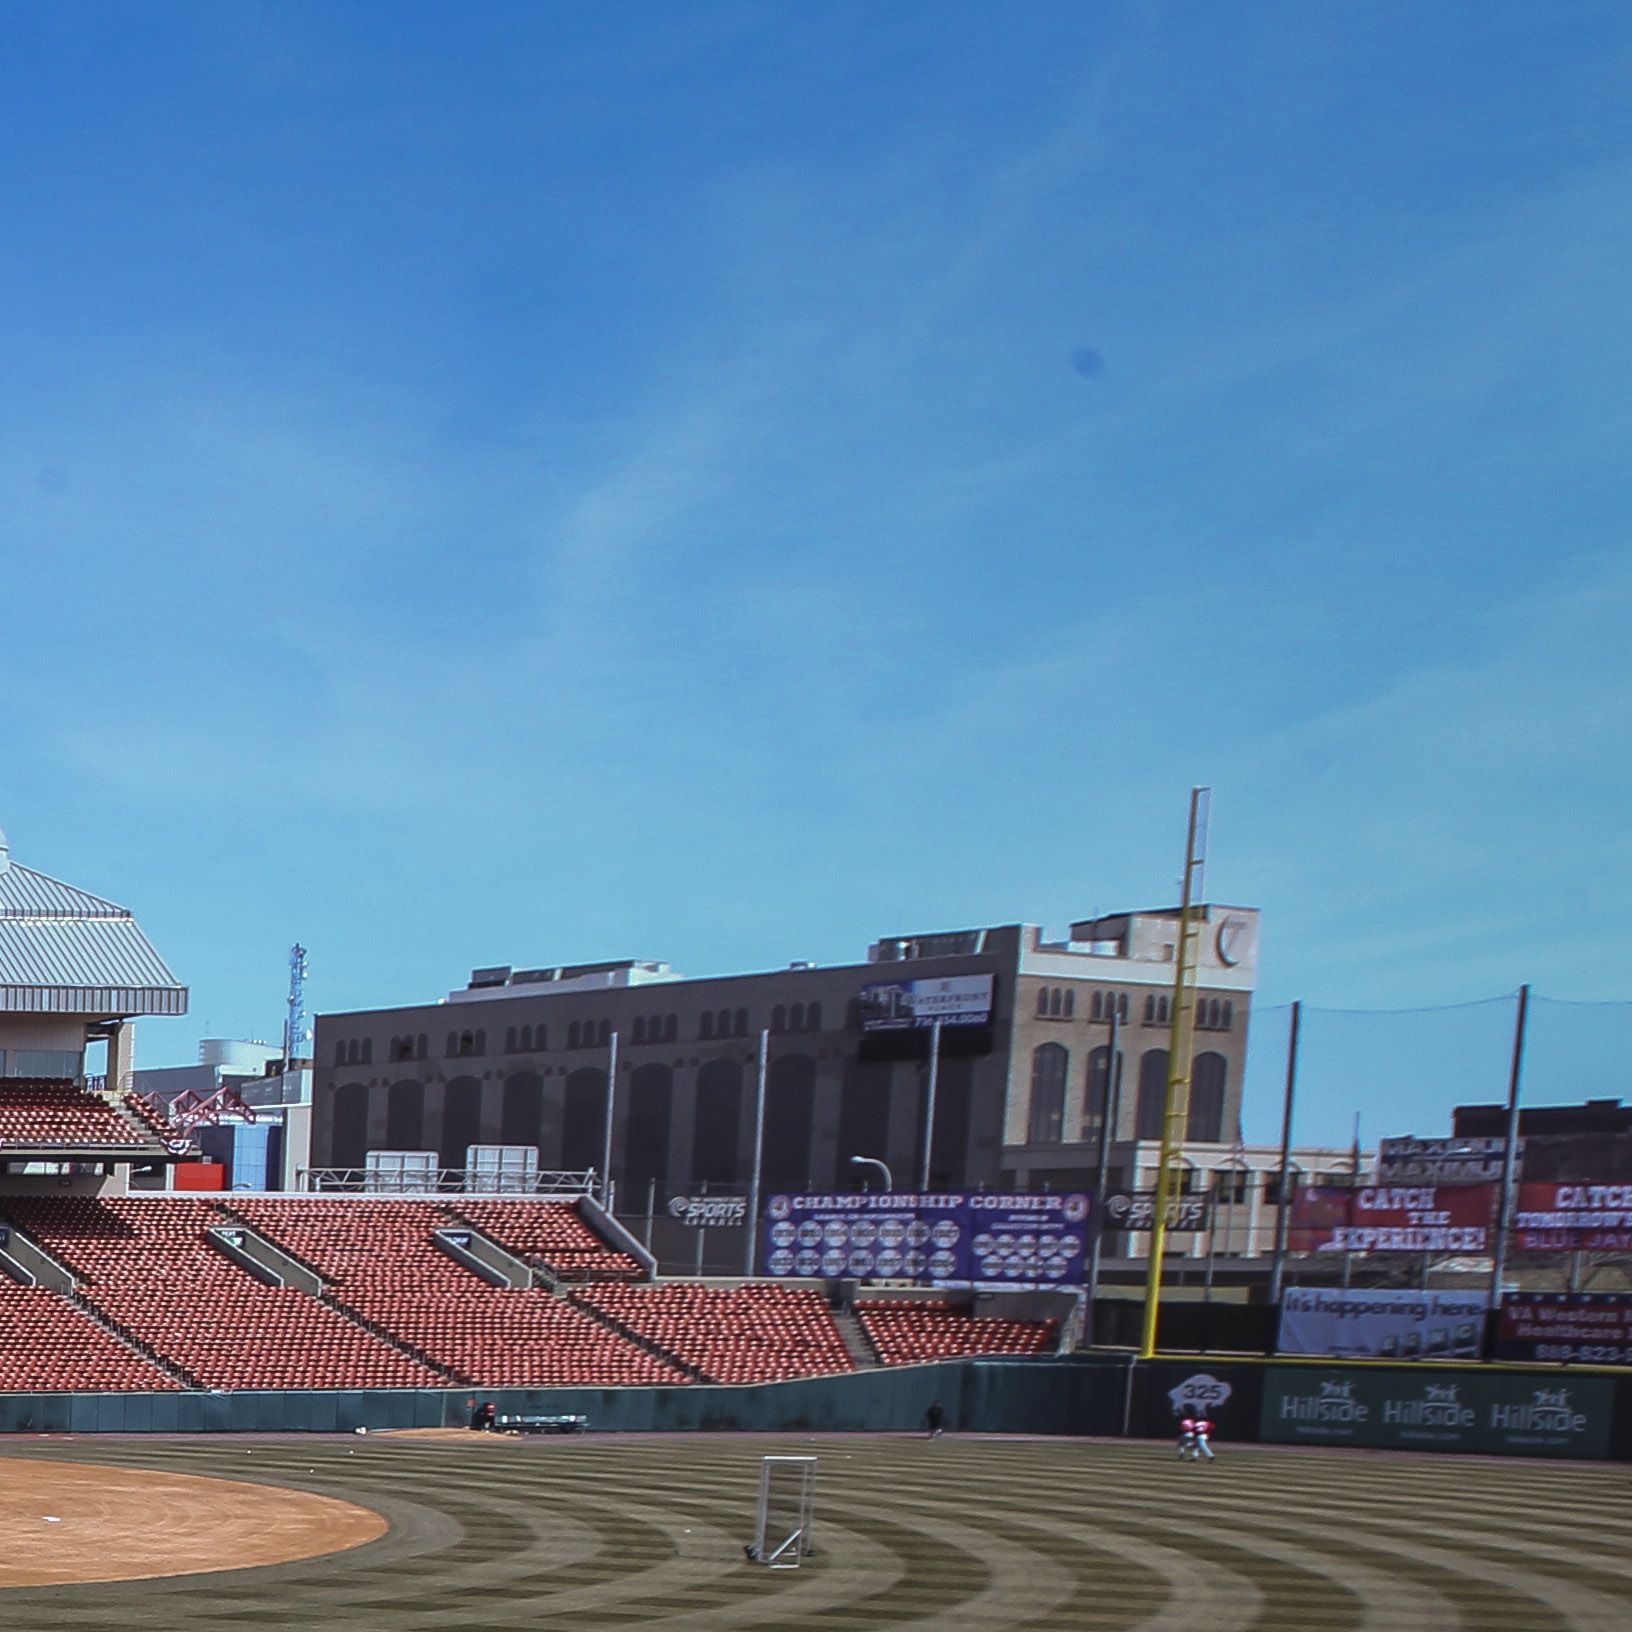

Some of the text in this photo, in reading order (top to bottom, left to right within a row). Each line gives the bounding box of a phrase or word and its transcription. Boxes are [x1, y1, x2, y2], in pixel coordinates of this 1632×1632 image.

[792, 1196, 1063, 1210] CHAMPIONSHIP CORNER
[1357, 1187, 1435, 1210] CATCH
[687, 1203, 747, 1218] SPORTS
[1408, 1211, 1451, 1225] THE
[1335, 1227, 1486, 1250] EXPERIENCE!
[1314, 1294, 1428, 1322] happening
[1184, 1384, 1220, 1400] 325
[1280, 1395, 1369, 1422] Hillside
[1383, 1400, 1475, 1428] Hillside
[1490, 1404, 1588, 1432] Hillside
